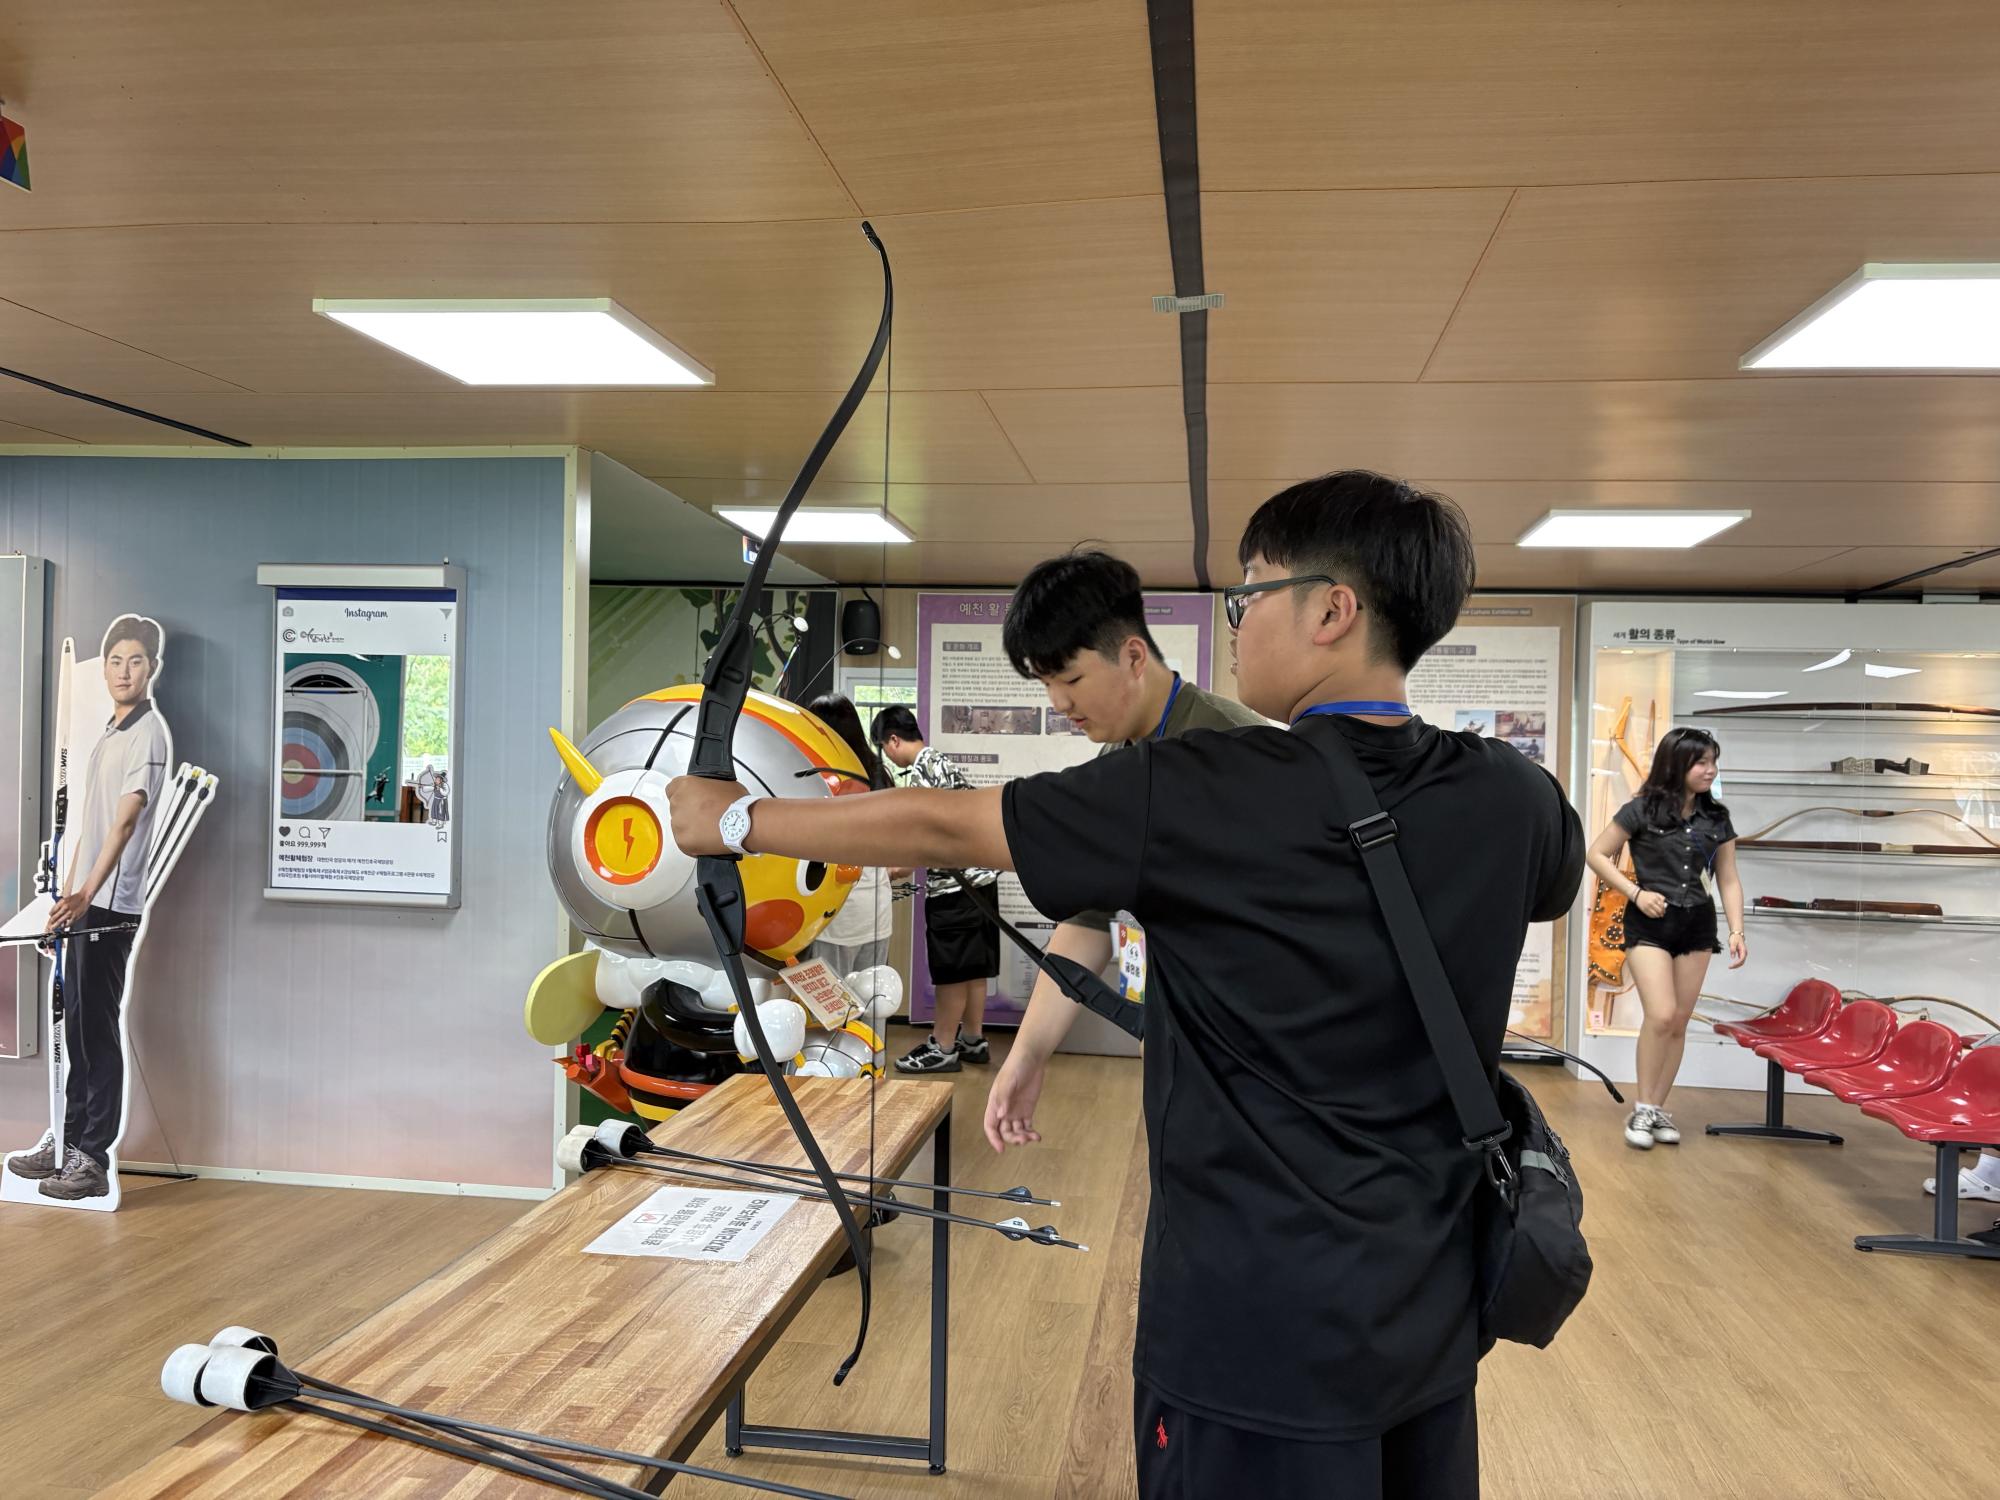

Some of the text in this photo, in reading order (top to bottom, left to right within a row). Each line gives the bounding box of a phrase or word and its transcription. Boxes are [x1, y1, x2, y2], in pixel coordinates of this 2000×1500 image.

[345, 608, 389, 621] Instagram
[960, 603, 983, 616] 예천
[1629, 628, 1650, 640] 활의
[1653, 628, 1676, 640] 종류
[278, 853, 313, 863] 예천활체험장
[641, 1197, 711, 1247] 원활한 체험을 위해
[702, 1199, 770, 1253] 제자리에 꽂아주세요
